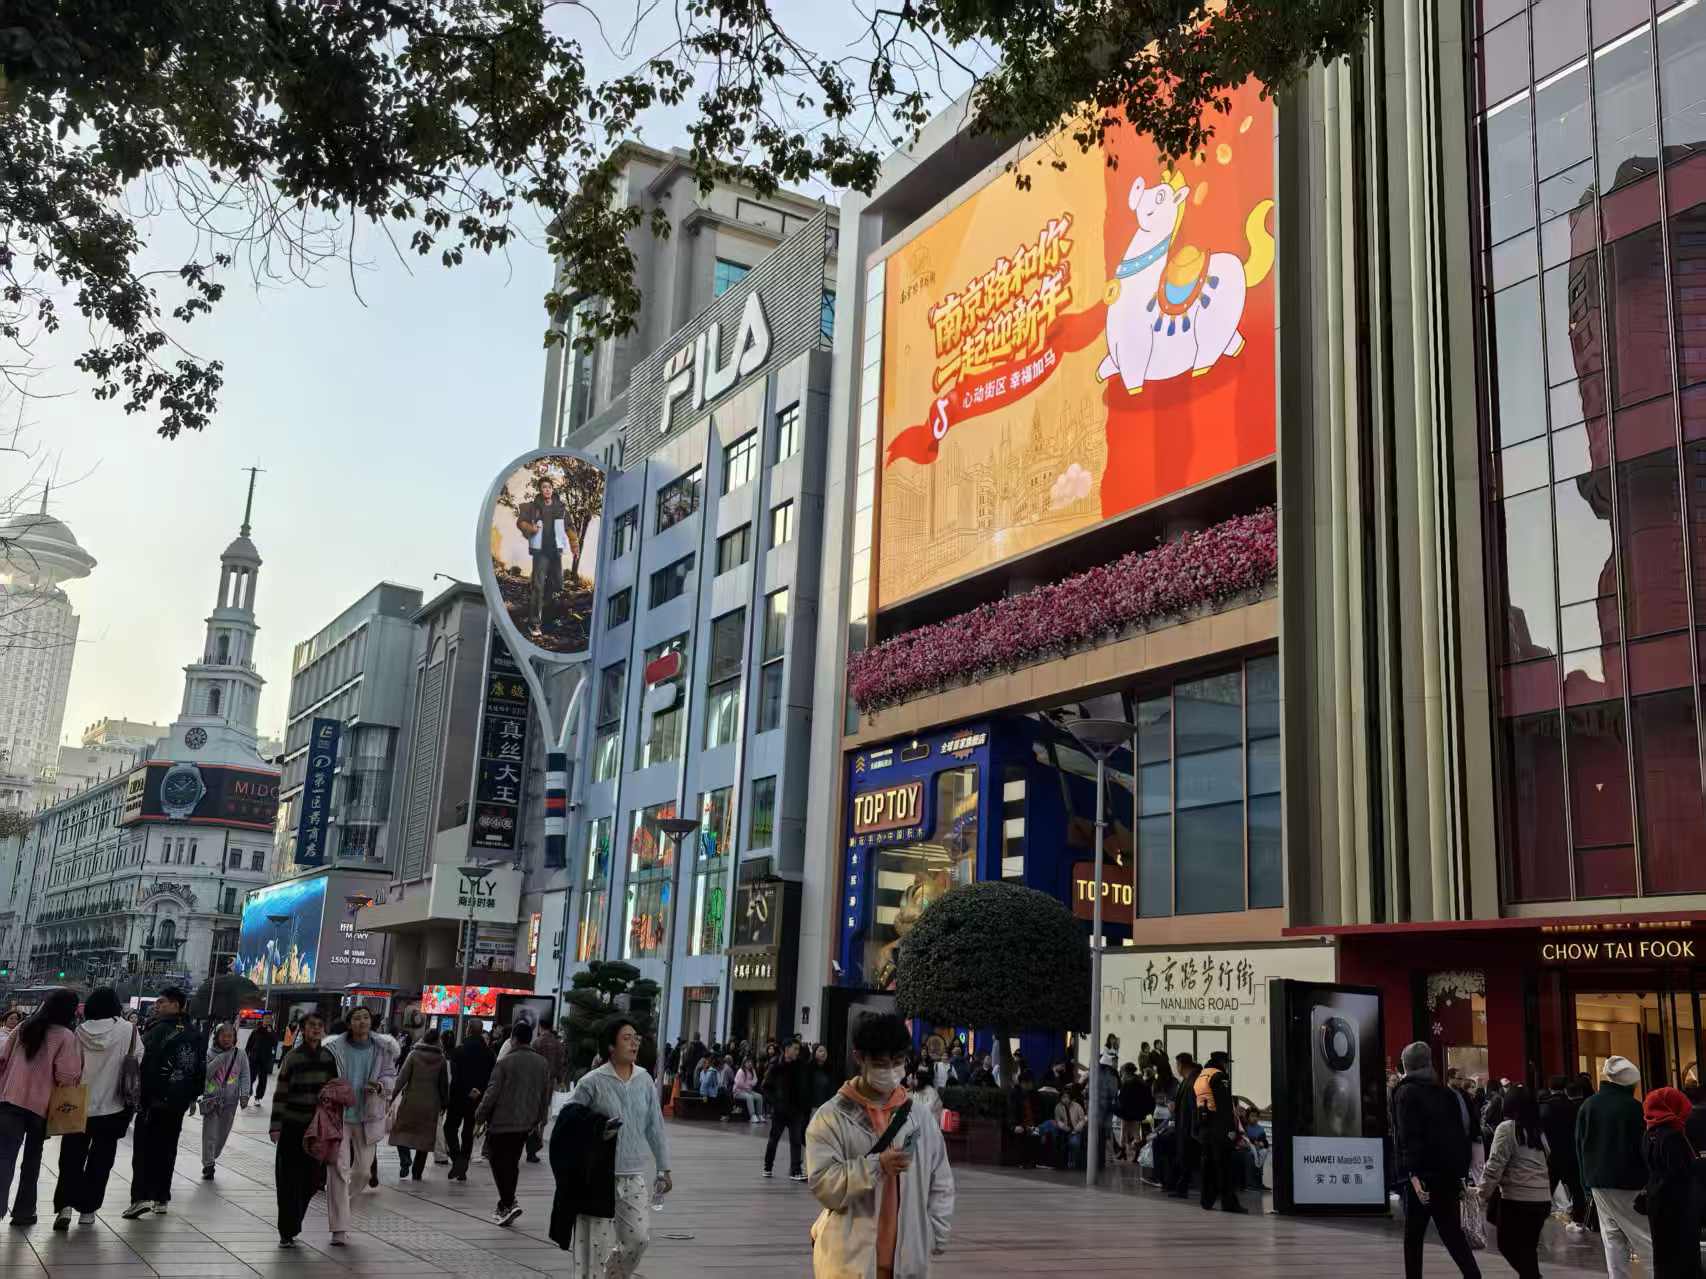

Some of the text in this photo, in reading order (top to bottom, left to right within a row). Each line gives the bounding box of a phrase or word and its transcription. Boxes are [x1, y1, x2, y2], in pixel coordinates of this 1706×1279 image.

[929, 213, 1073, 357] 南京路和你
[934, 265, 1072, 392] 一起迎新年
[659, 290, 772, 435] FILA
[962, 350, 1056, 408] 心动街区 幸福加马
[492, 720, 525, 804] 真丝大王
[854, 784, 920, 828] TOP TOY
[1111, 883, 1134, 906] TO
[1542, 940, 1695, 960] CHOW TAI FOOK
[1143, 954, 1256, 997] 南京路步行街
[1160, 997, 1239, 1011] NANJING ROAD
[1303, 1155, 1335, 1165] HUAWEI
